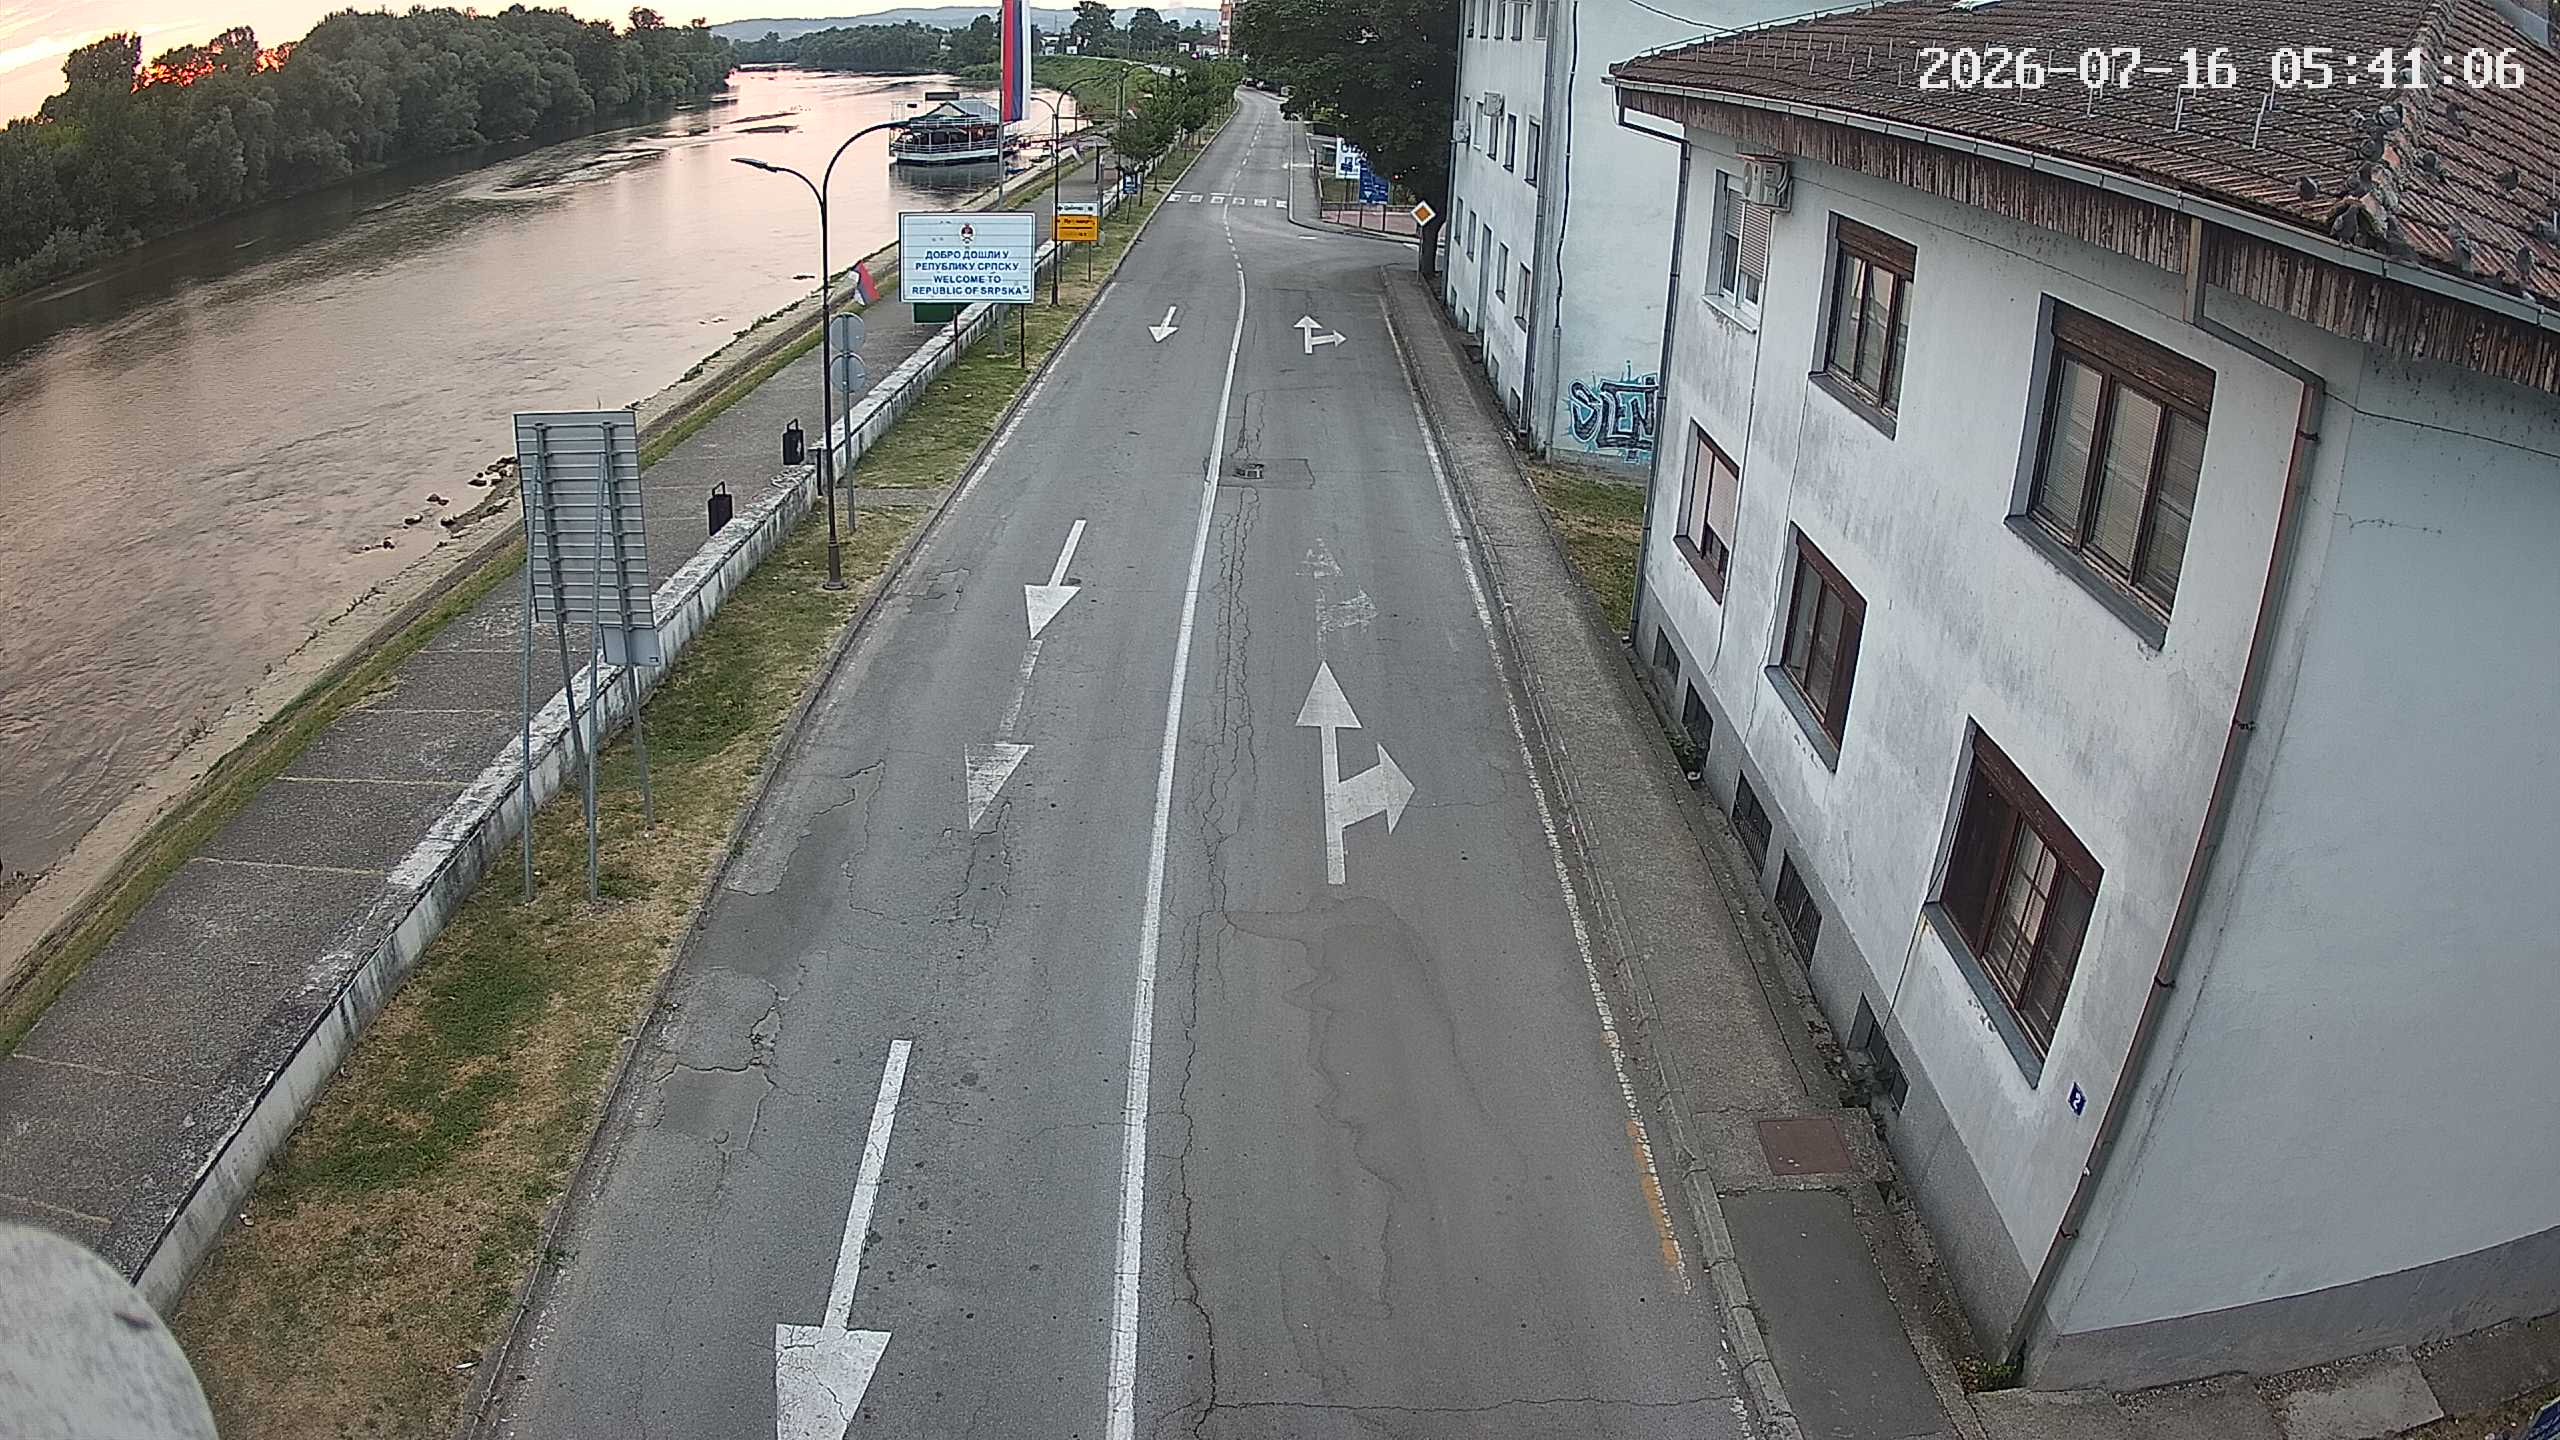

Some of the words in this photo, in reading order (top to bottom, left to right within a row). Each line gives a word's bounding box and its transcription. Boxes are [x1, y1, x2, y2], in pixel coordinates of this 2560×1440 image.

[925, 250, 960, 260] ДОБРО
[962, 250, 1000, 260] ДОШЛИ
[1002, 250, 1009, 259] У
[915, 262, 975, 271] РЕПУБЛИКУ
[977, 262, 1019, 271] СРПСКУ
[933, 275, 985, 284] WELCOME
[988, 275, 1001, 284] TO
[912, 286, 963, 295] REPUBLIC
[964, 286, 979, 295] OF
[980, 286, 1022, 295] SRPSKA
[2073, 1092, 2081, 1110] 2
